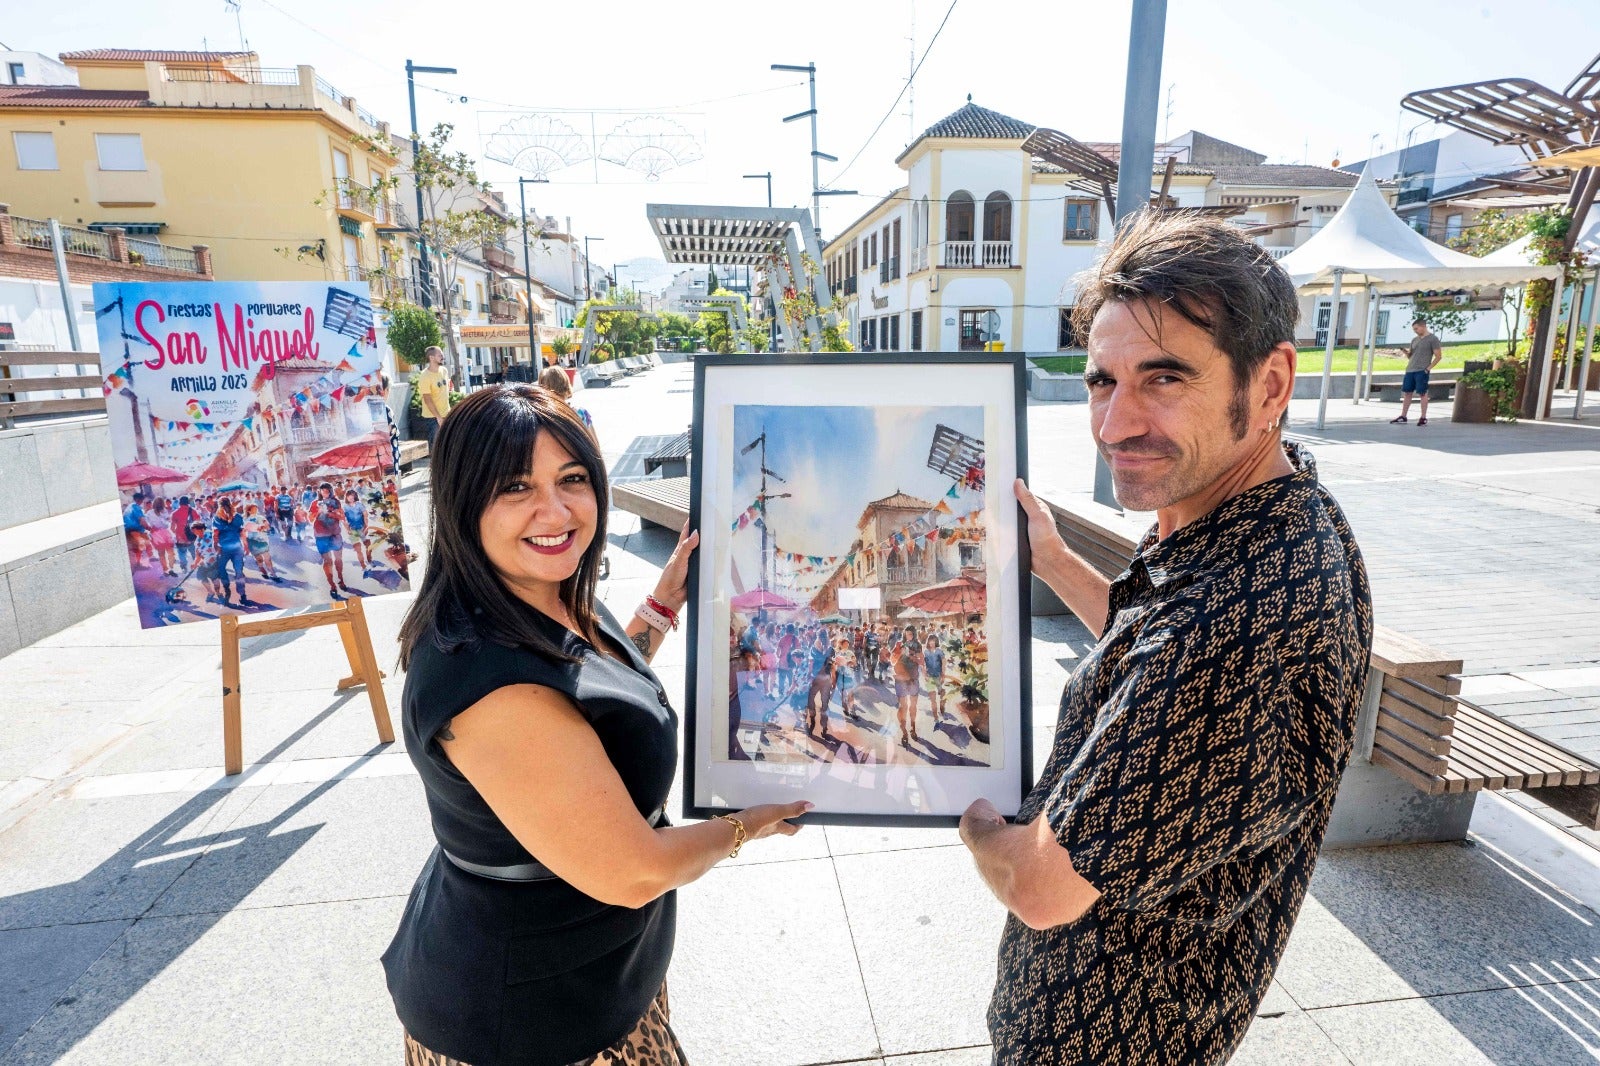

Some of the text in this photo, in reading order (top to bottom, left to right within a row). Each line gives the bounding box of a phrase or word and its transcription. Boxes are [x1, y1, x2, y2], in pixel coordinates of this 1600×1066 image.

[135, 300, 319, 380] San Miguel
[221, 373, 248, 390] 2025
